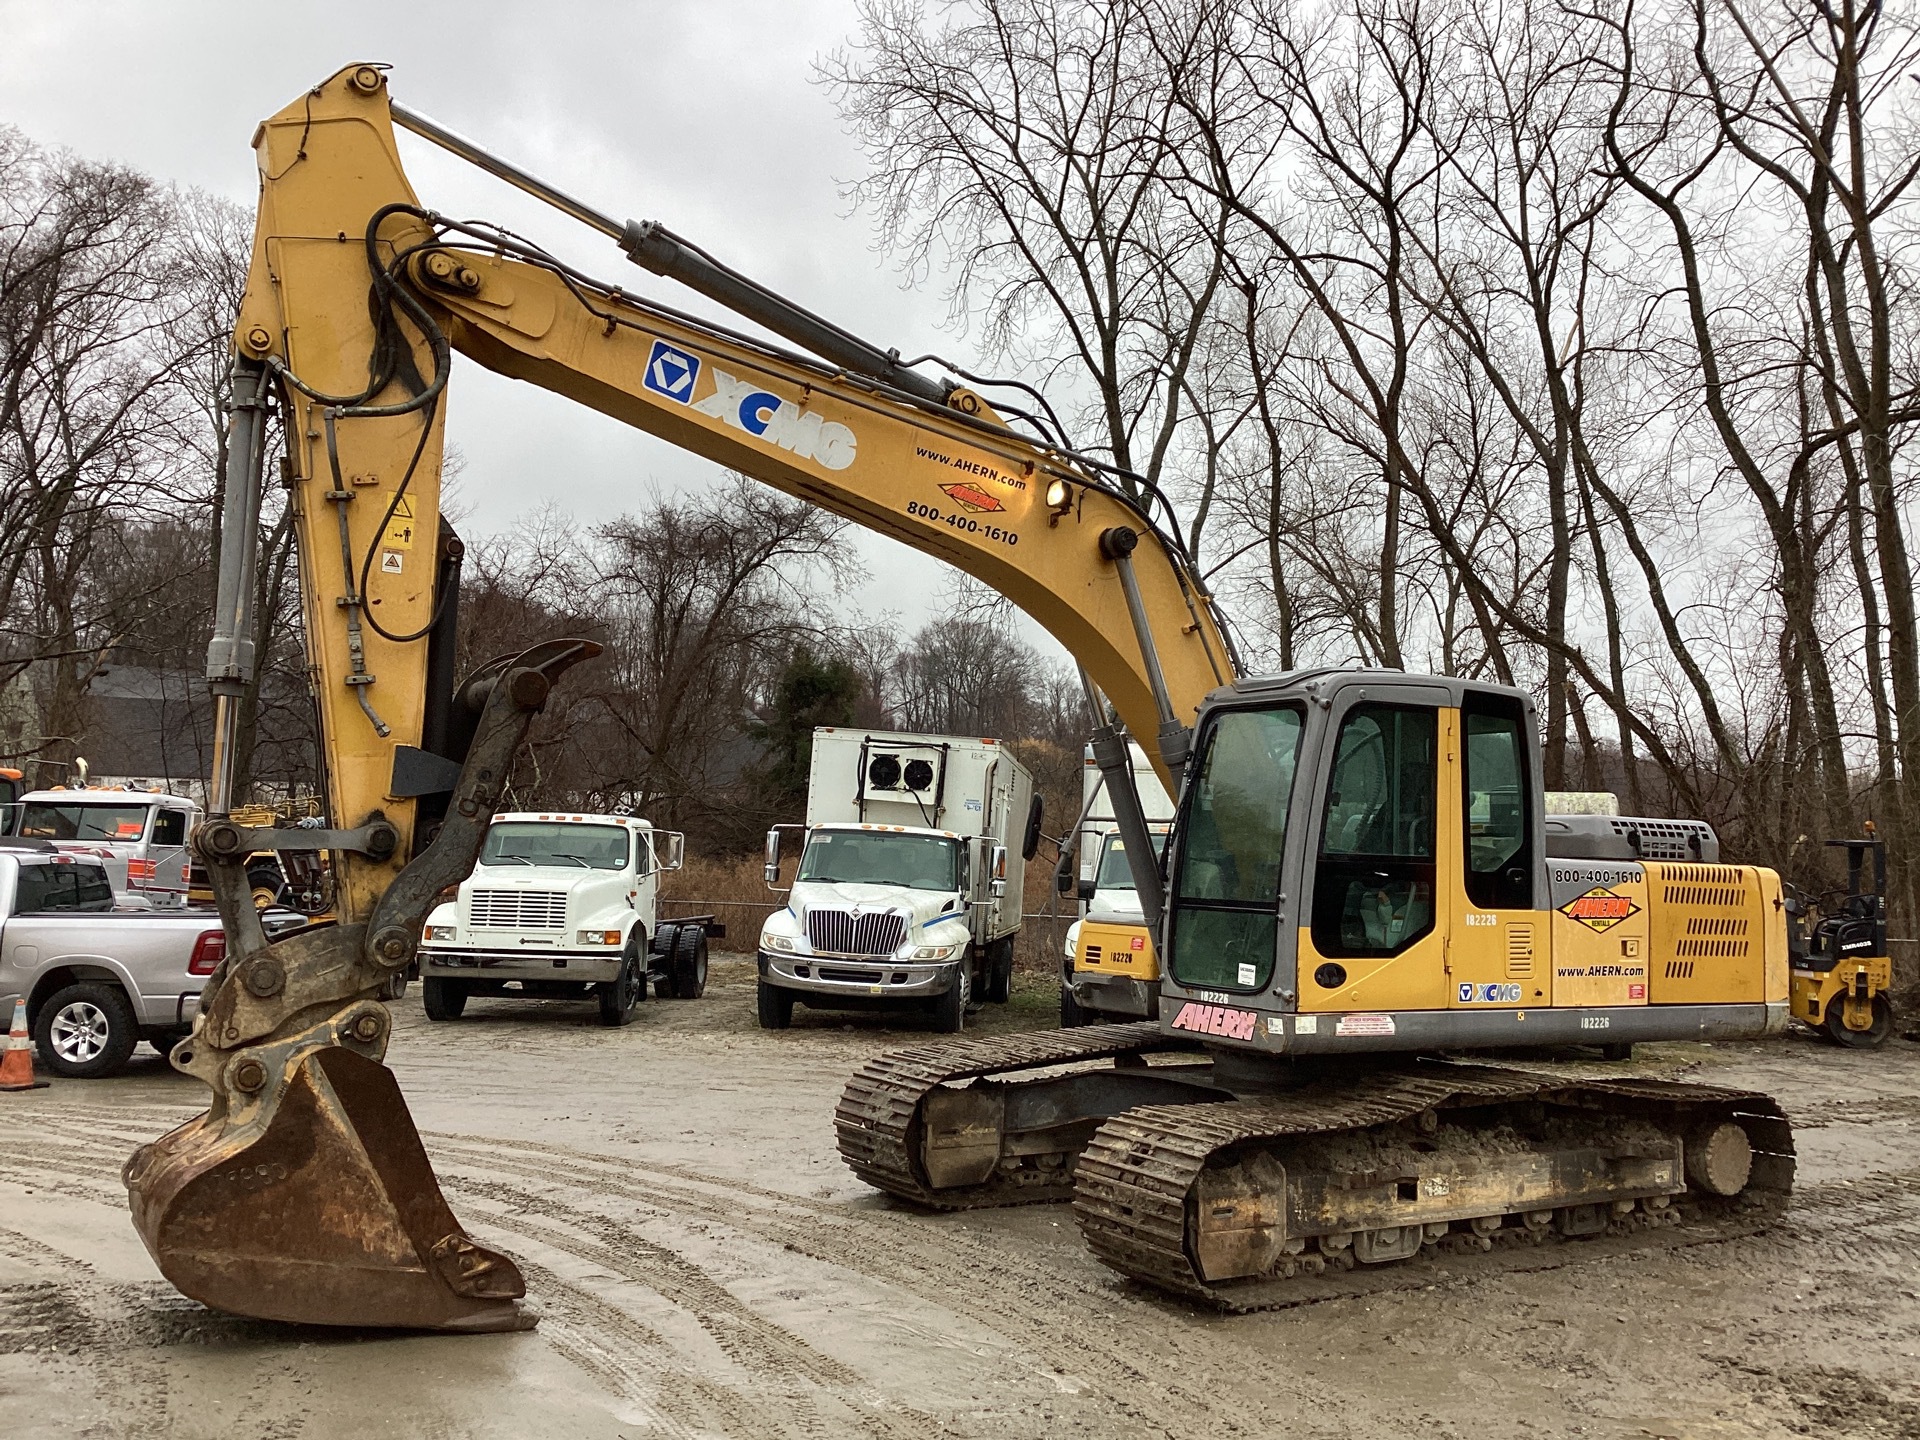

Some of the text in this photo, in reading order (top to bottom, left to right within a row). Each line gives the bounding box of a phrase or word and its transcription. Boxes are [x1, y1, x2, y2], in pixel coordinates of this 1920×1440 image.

[688, 366, 857, 470] XCMG
[916, 446, 1027, 491] www.AHERN.com
[906, 501, 1019, 546] 800-400-1610
[1555, 869, 1642, 884] 800-400-1610
[1568, 897, 1631, 918] AHERN
[1466, 914, 1497, 926] 182226
[1110, 951, 1133, 964] 182226
[1557, 965, 1644, 977] www.AHERN.com
[1200, 991, 1229, 1004] 182226
[1474, 983, 1522, 1002] XCMG
[1171, 1002, 1258, 1041] AHERN
[1580, 1017, 1610, 1029] 182226
